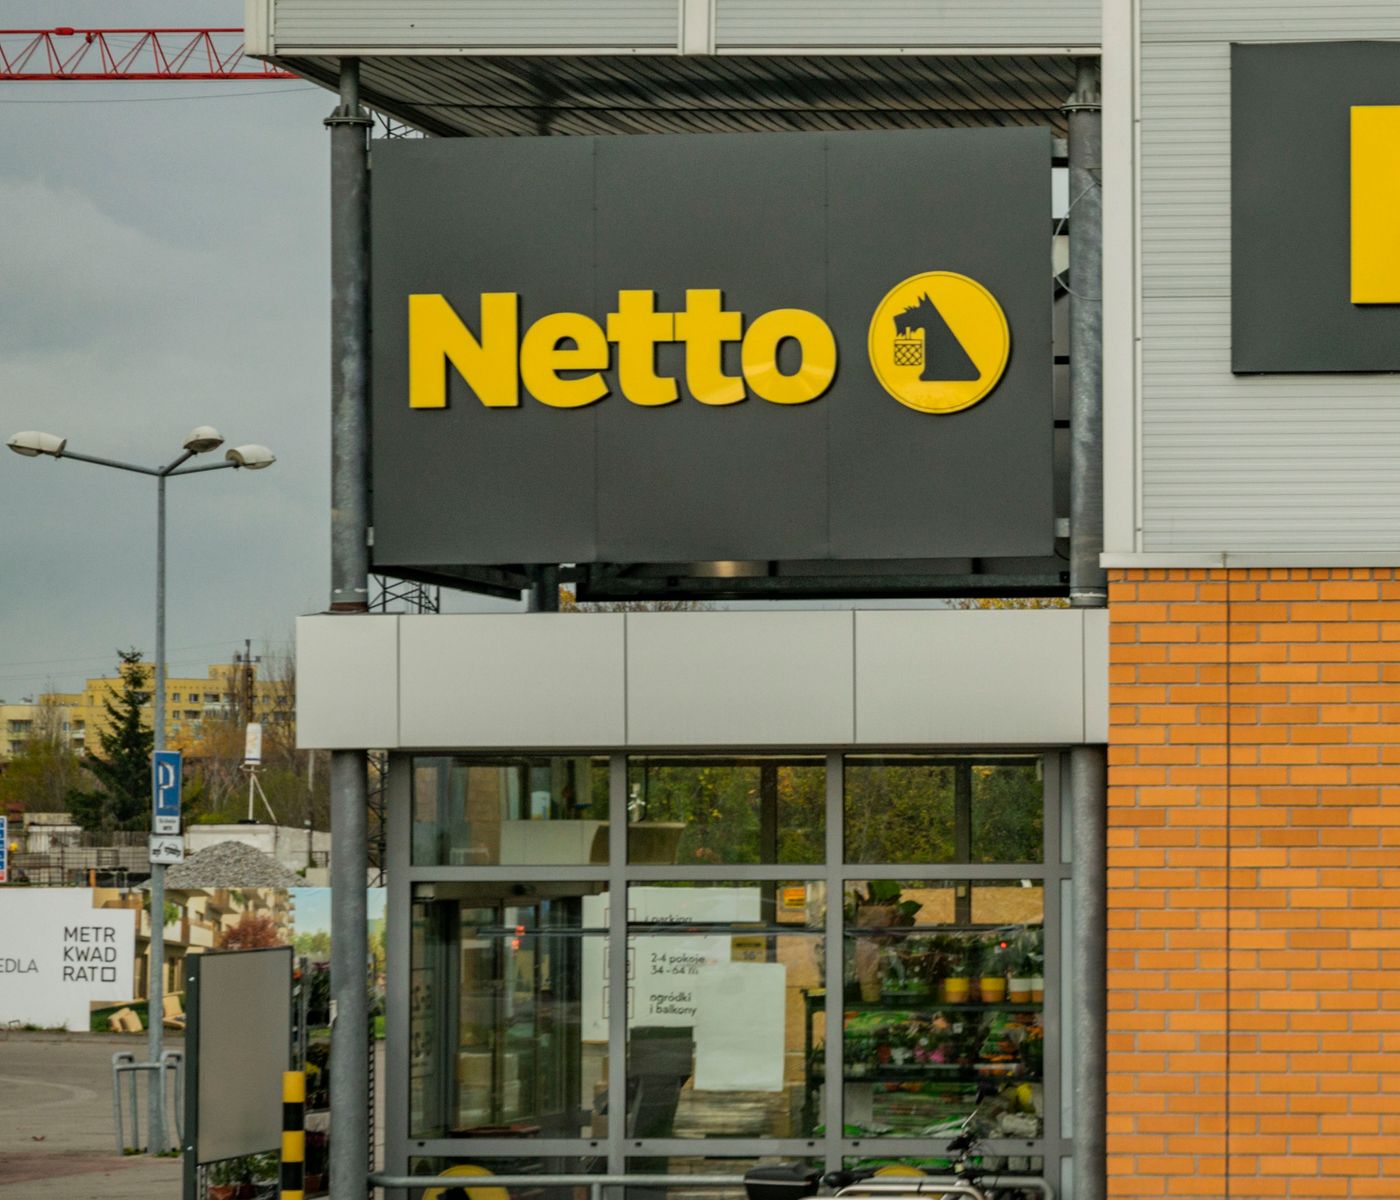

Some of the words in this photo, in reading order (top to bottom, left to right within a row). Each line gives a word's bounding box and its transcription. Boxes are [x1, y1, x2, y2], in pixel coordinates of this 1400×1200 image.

[408, 288, 836, 408] Netto
[158, 761, 175, 808] P
[64, 926, 116, 942] METR
[63, 946, 117, 962] KWAD
[650, 992, 691, 1004] ogródki
[656, 1004, 698, 1017] balkony
